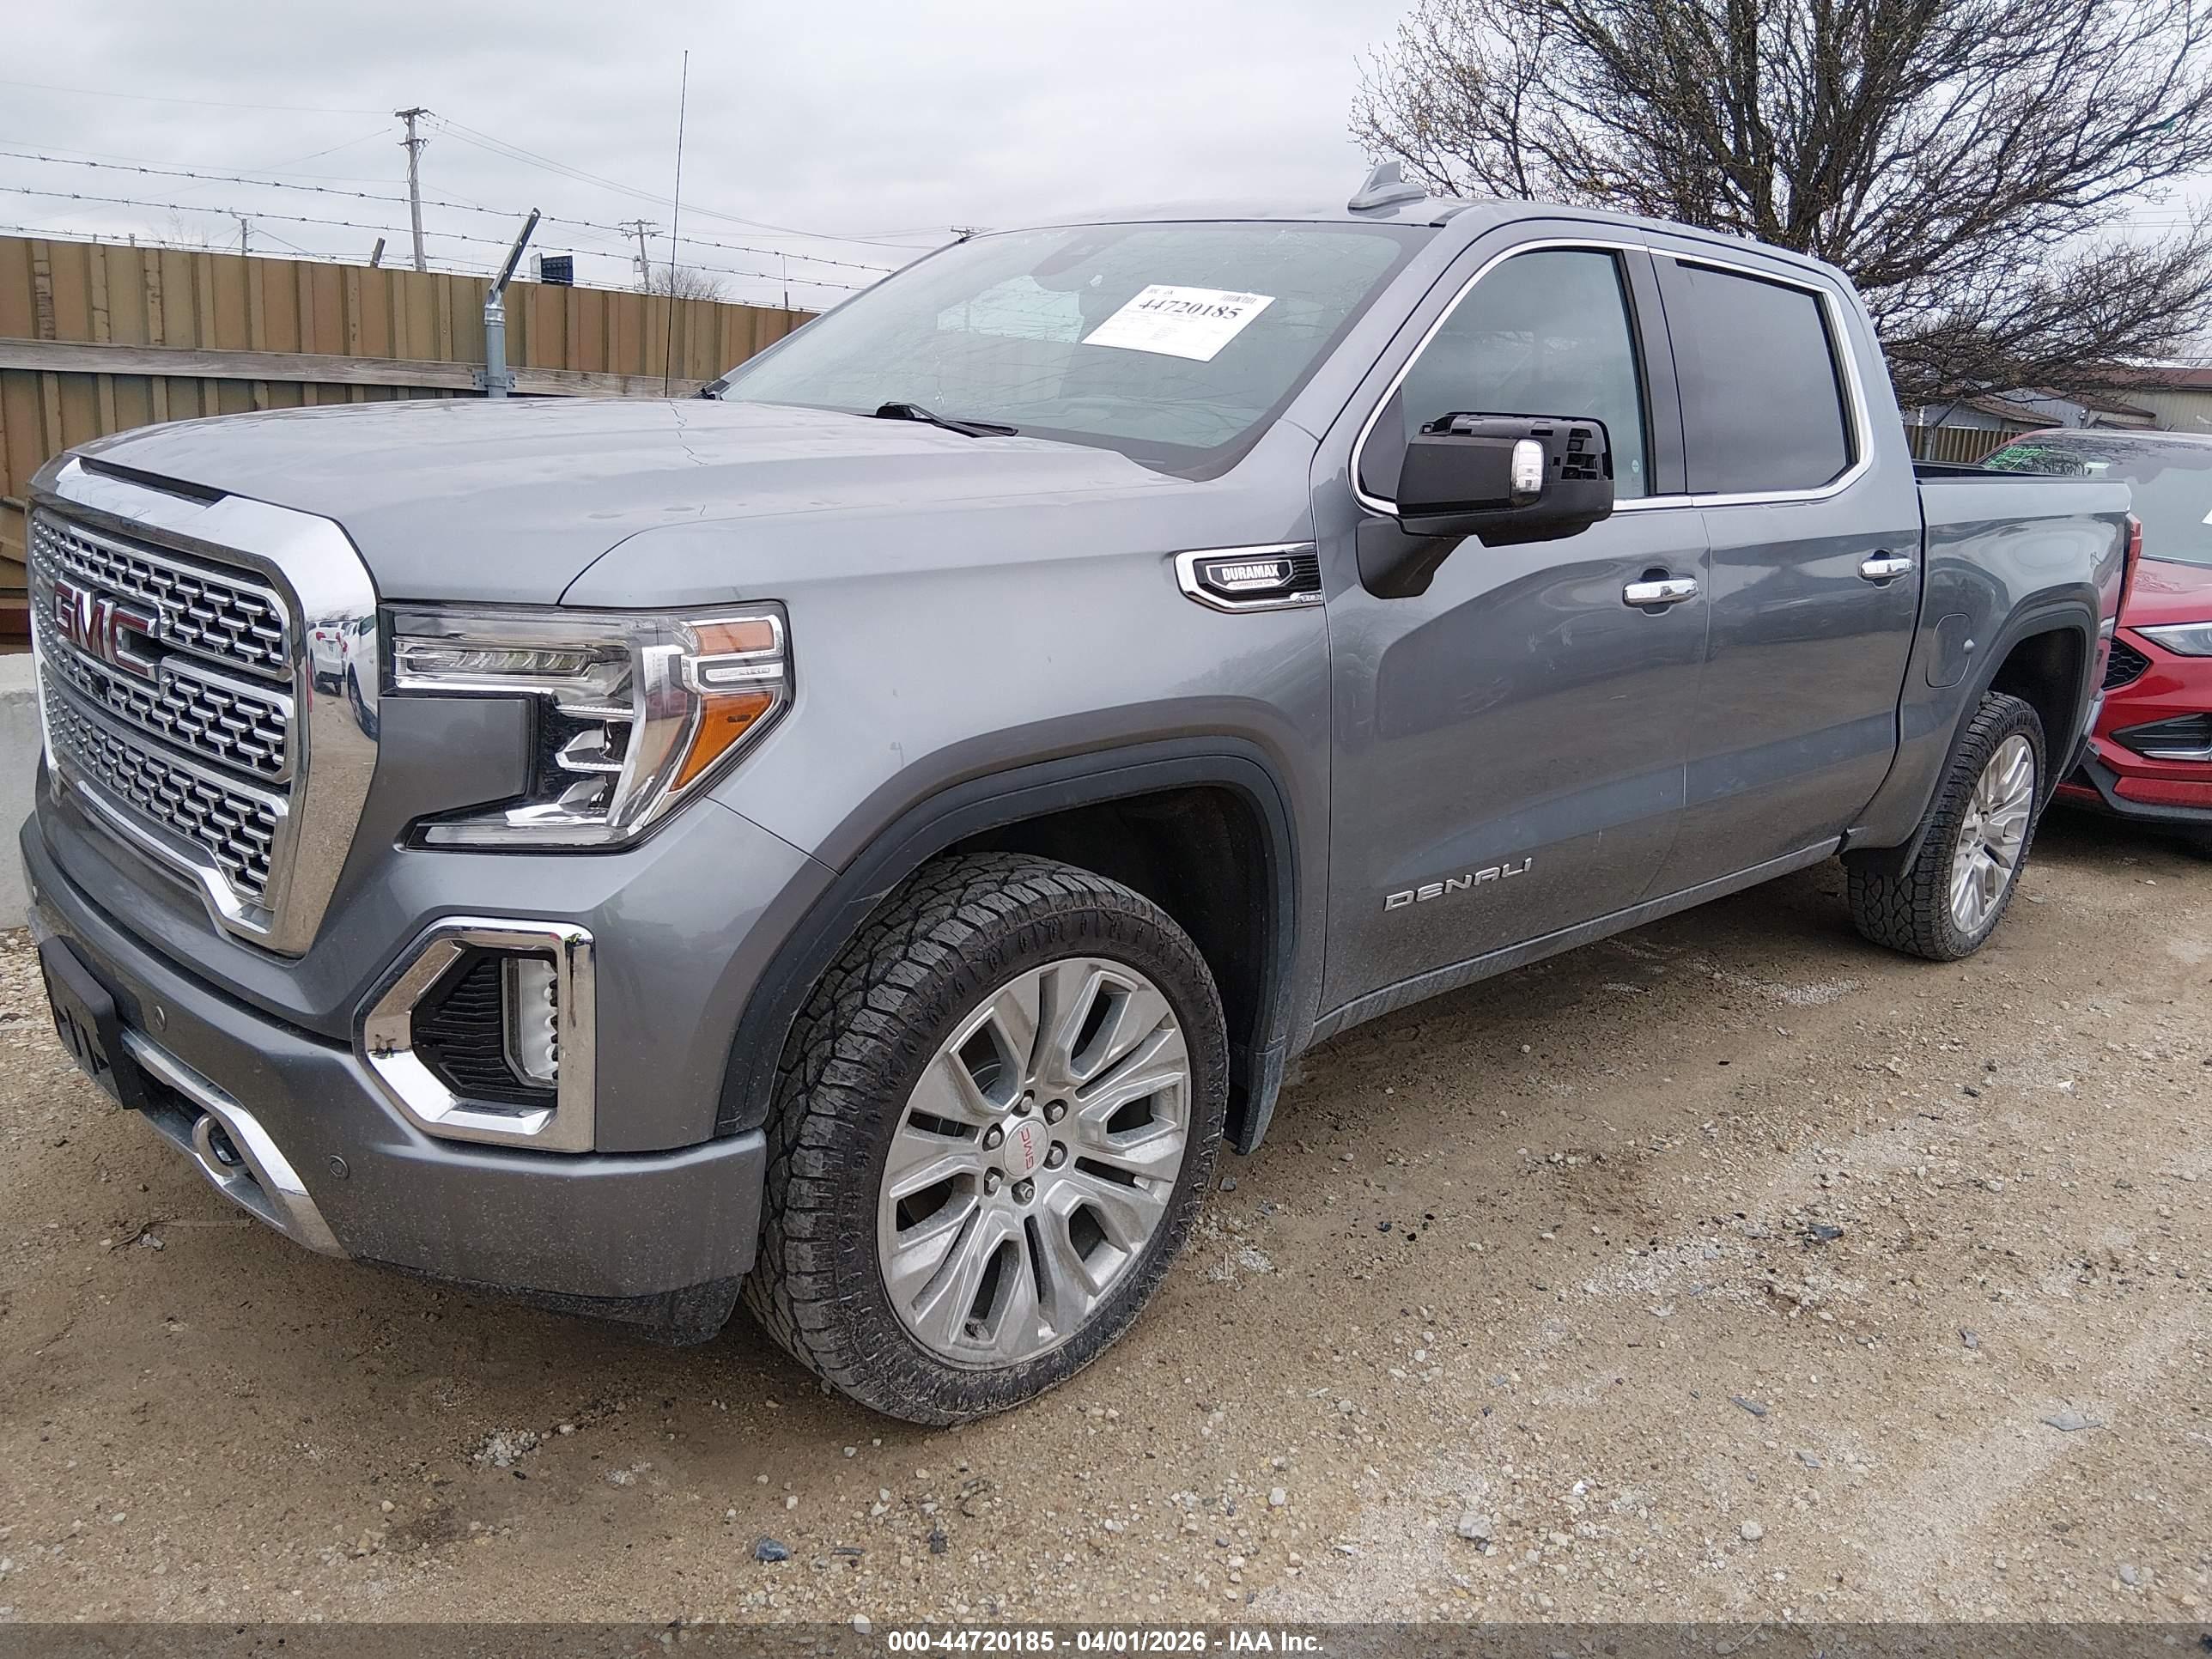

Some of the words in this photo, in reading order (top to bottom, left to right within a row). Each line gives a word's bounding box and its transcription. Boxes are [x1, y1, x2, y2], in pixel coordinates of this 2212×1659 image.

[1139, 298, 1243, 319] 44720185
[1221, 564, 1279, 581] DURAMAX
[54, 578, 158, 684] GMC
[1383, 857, 1532, 912] DENALI
[1020, 1127, 1034, 1170] GMC
